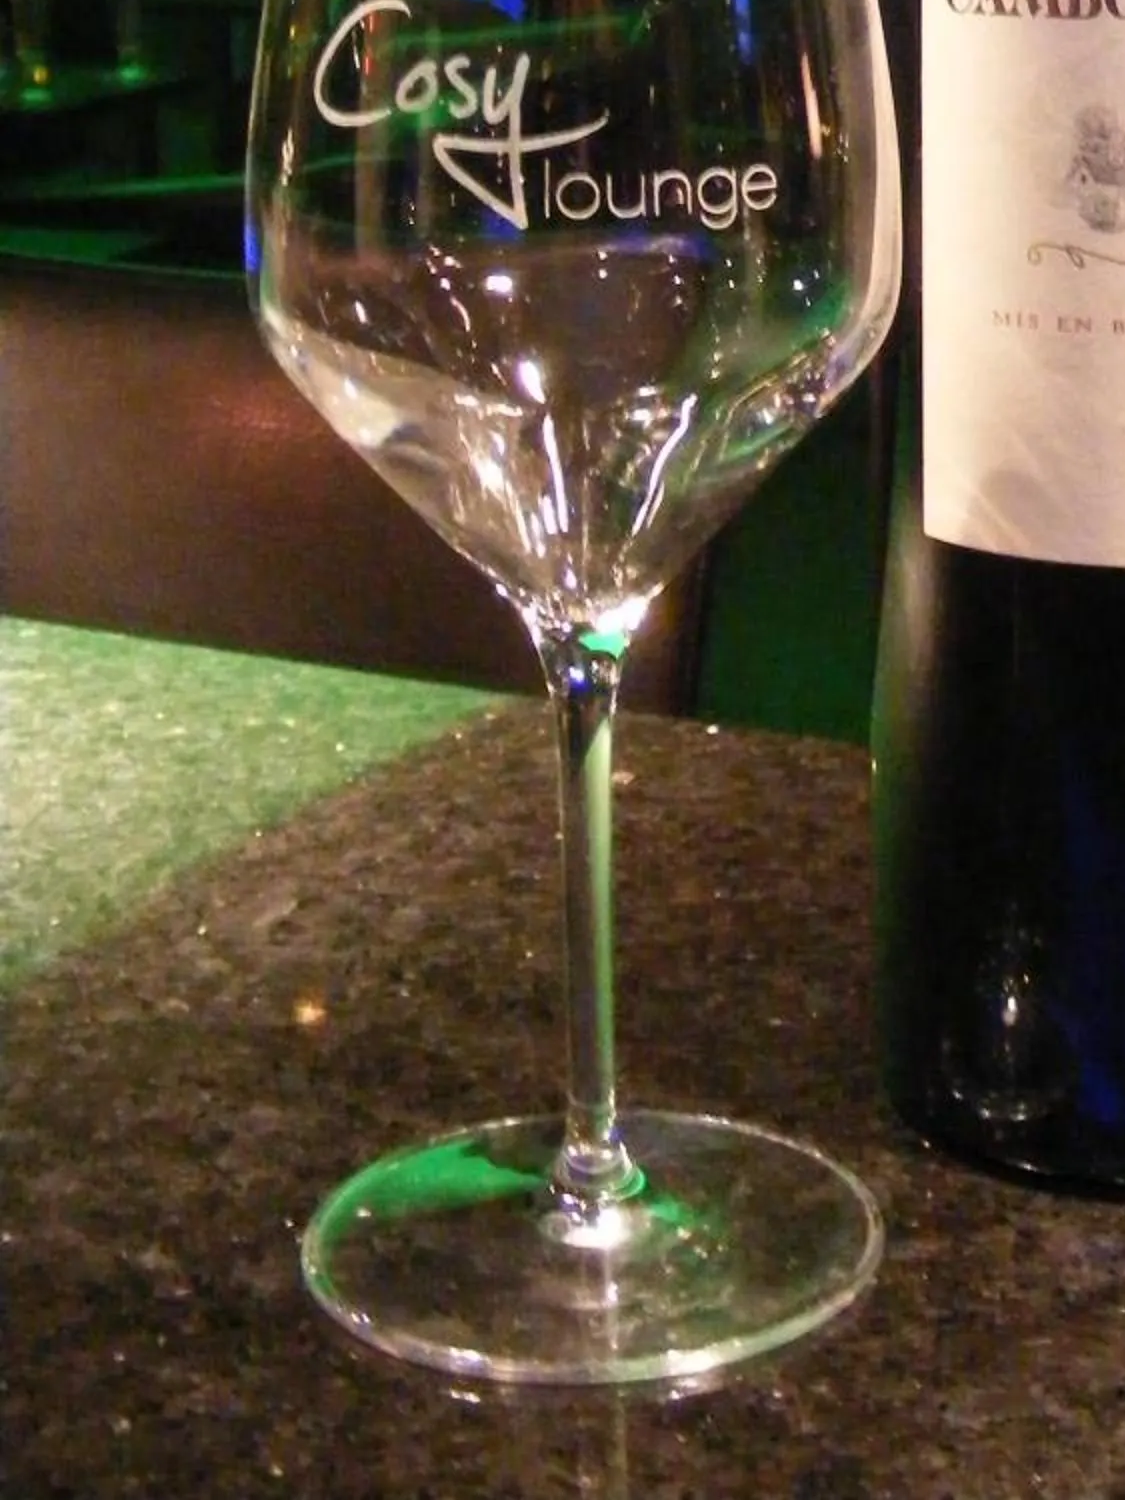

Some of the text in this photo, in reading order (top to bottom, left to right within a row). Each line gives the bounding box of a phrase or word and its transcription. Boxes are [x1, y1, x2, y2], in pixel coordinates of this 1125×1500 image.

[543, 158, 779, 230] lounge
[992, 309, 1040, 331] MIS
[1056, 314, 1093, 335] EN
